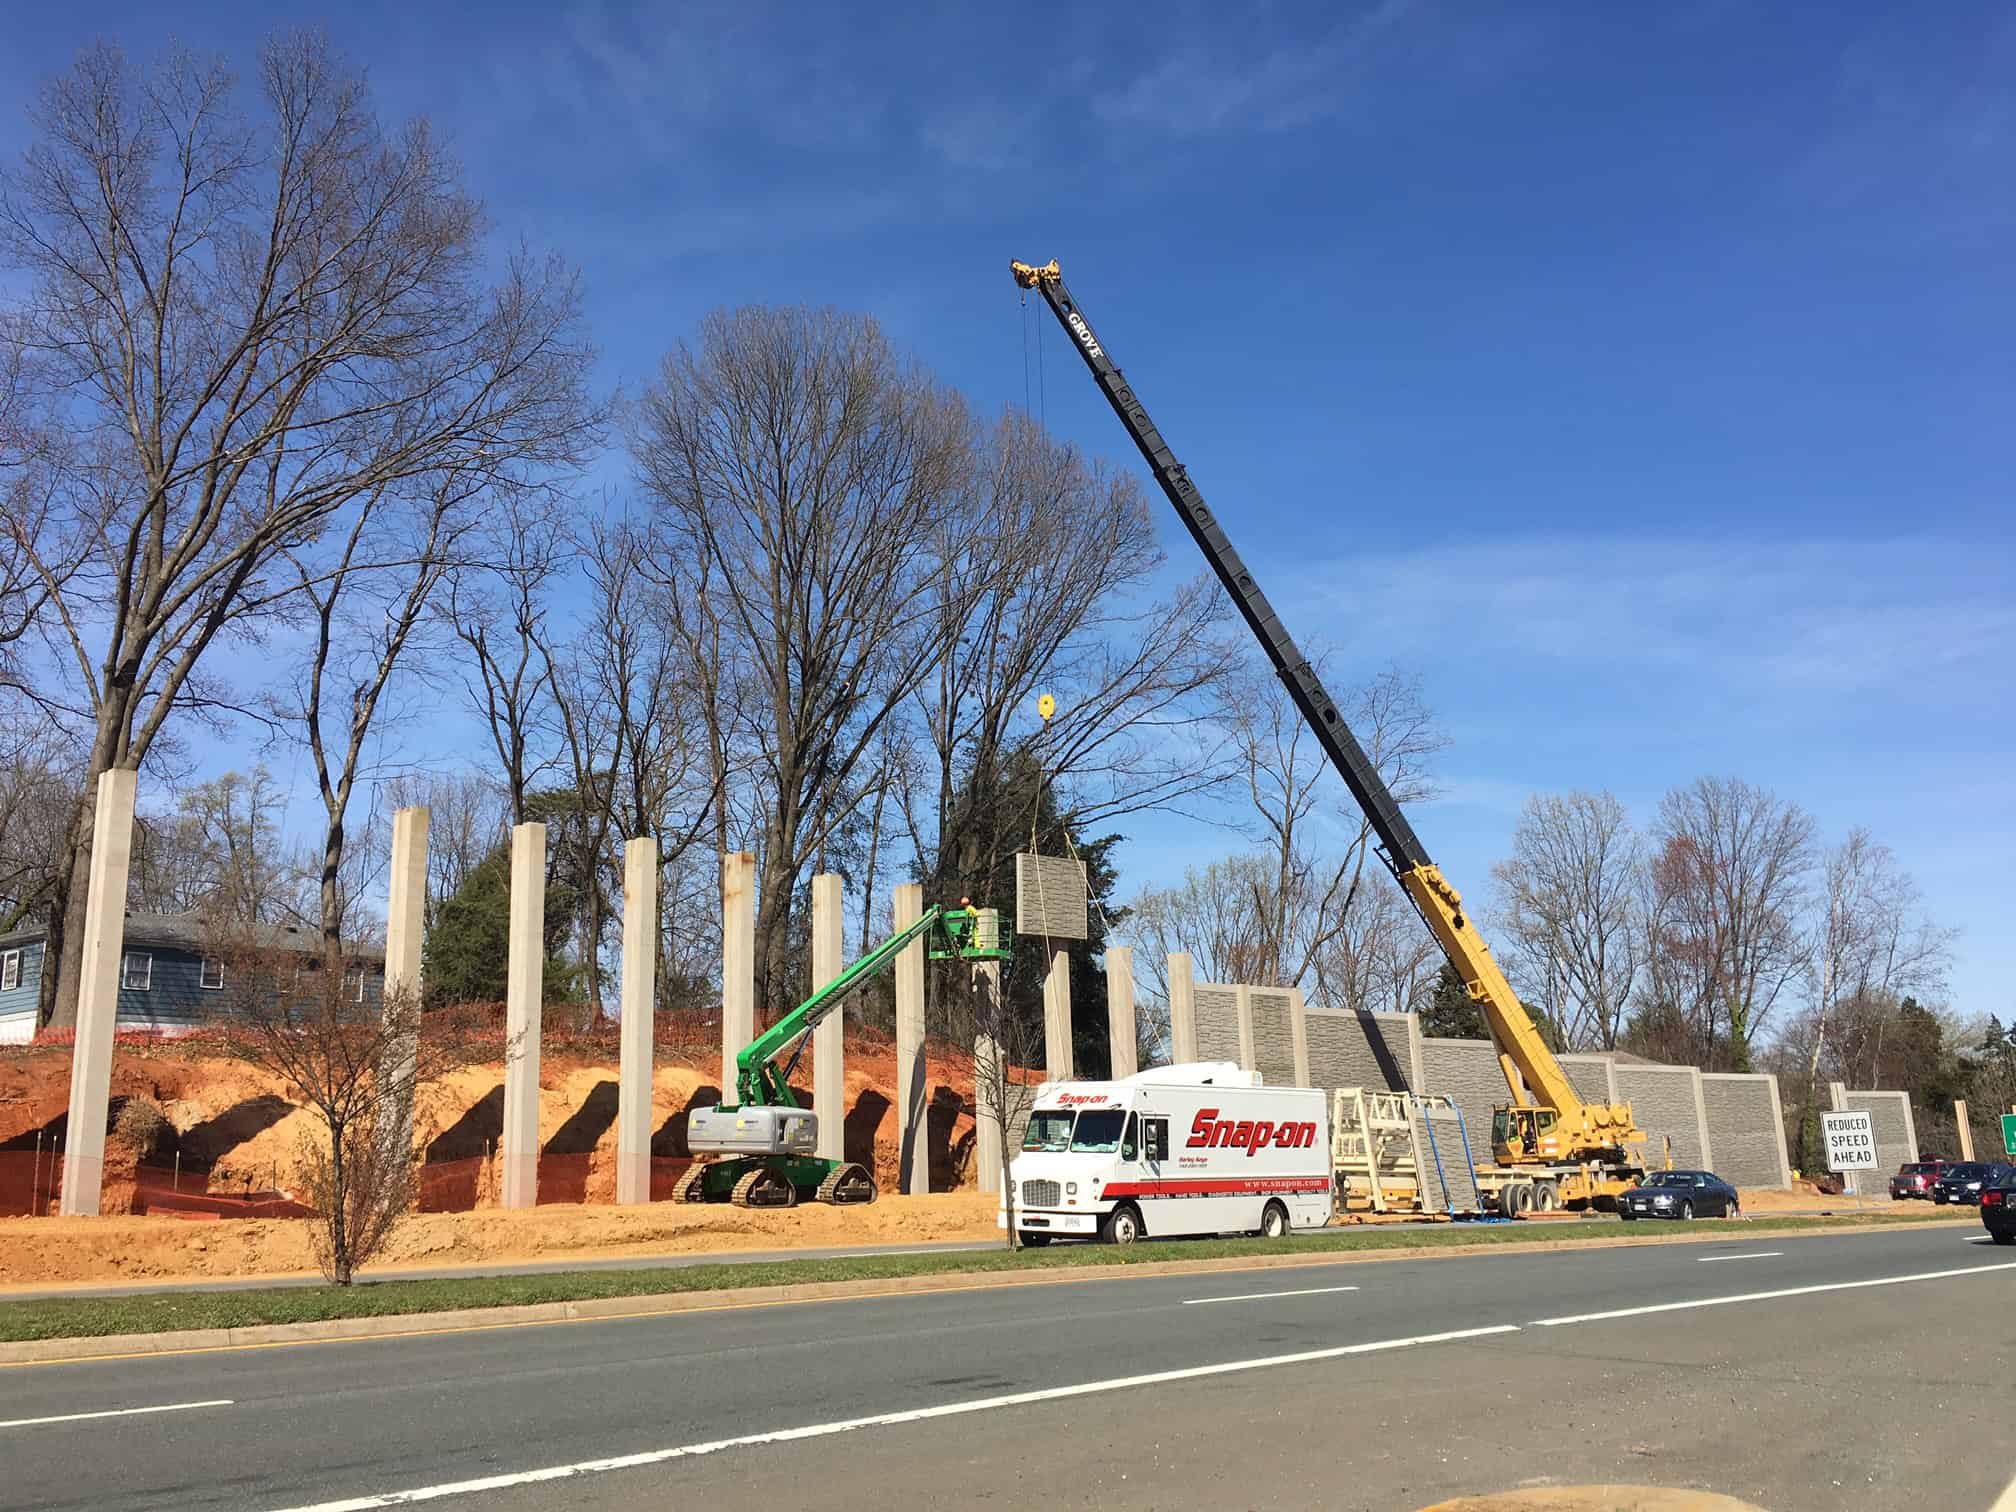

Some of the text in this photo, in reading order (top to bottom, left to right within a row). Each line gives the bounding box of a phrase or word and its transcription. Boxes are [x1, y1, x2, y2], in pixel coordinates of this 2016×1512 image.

[1068, 312, 1104, 358] GROVE
[1056, 1092, 1109, 1104] Snap-on
[1827, 1118, 1868, 1131] REDUCED
[1186, 1108, 1316, 1157] Snap-on
[1831, 1134, 1869, 1147] SPEED
[1833, 1151, 1872, 1163] AHEAD
[1243, 1179, 1323, 1190] www.snapon.com
